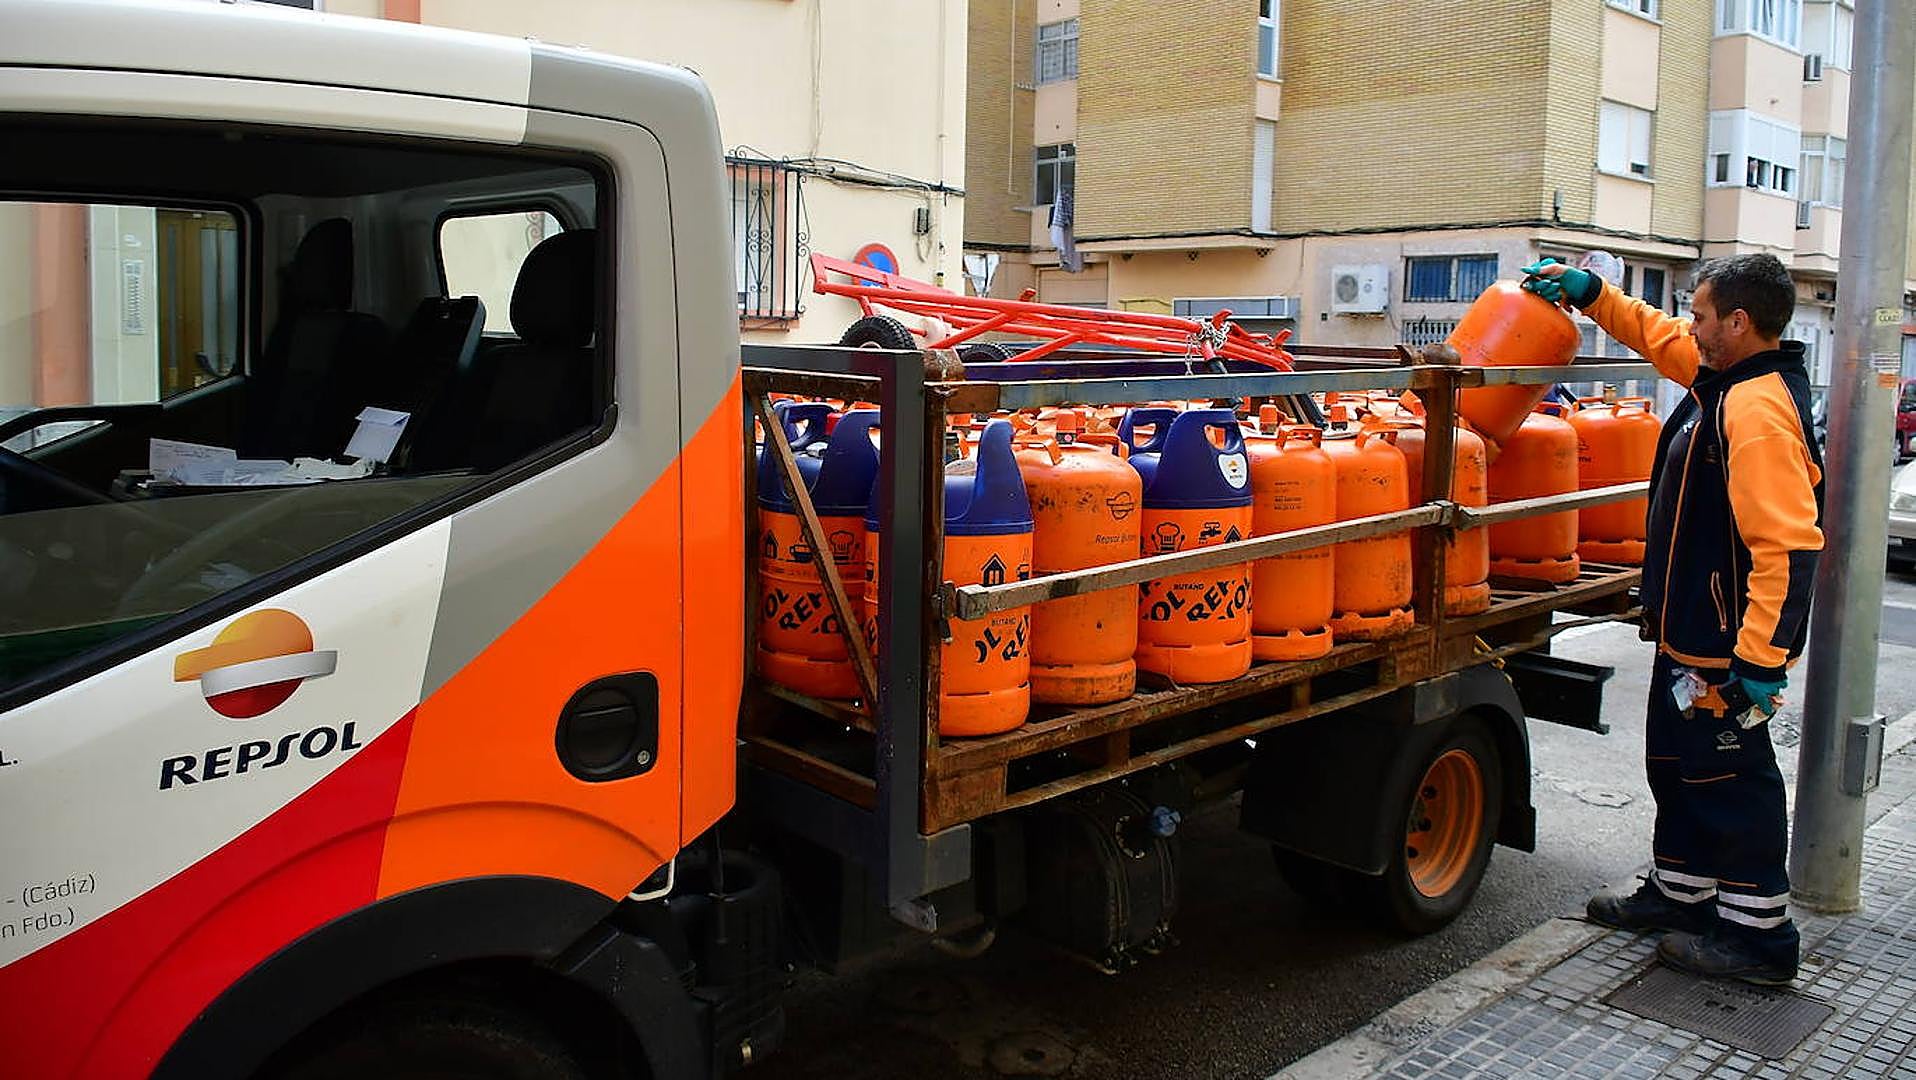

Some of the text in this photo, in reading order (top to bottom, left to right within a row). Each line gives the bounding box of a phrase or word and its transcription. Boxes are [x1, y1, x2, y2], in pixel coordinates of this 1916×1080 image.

[159, 721, 362, 790] REPSOL
[23, 873, 95, 908] (Cádiz)
[23, 906, 75, 934] Fdo.)
